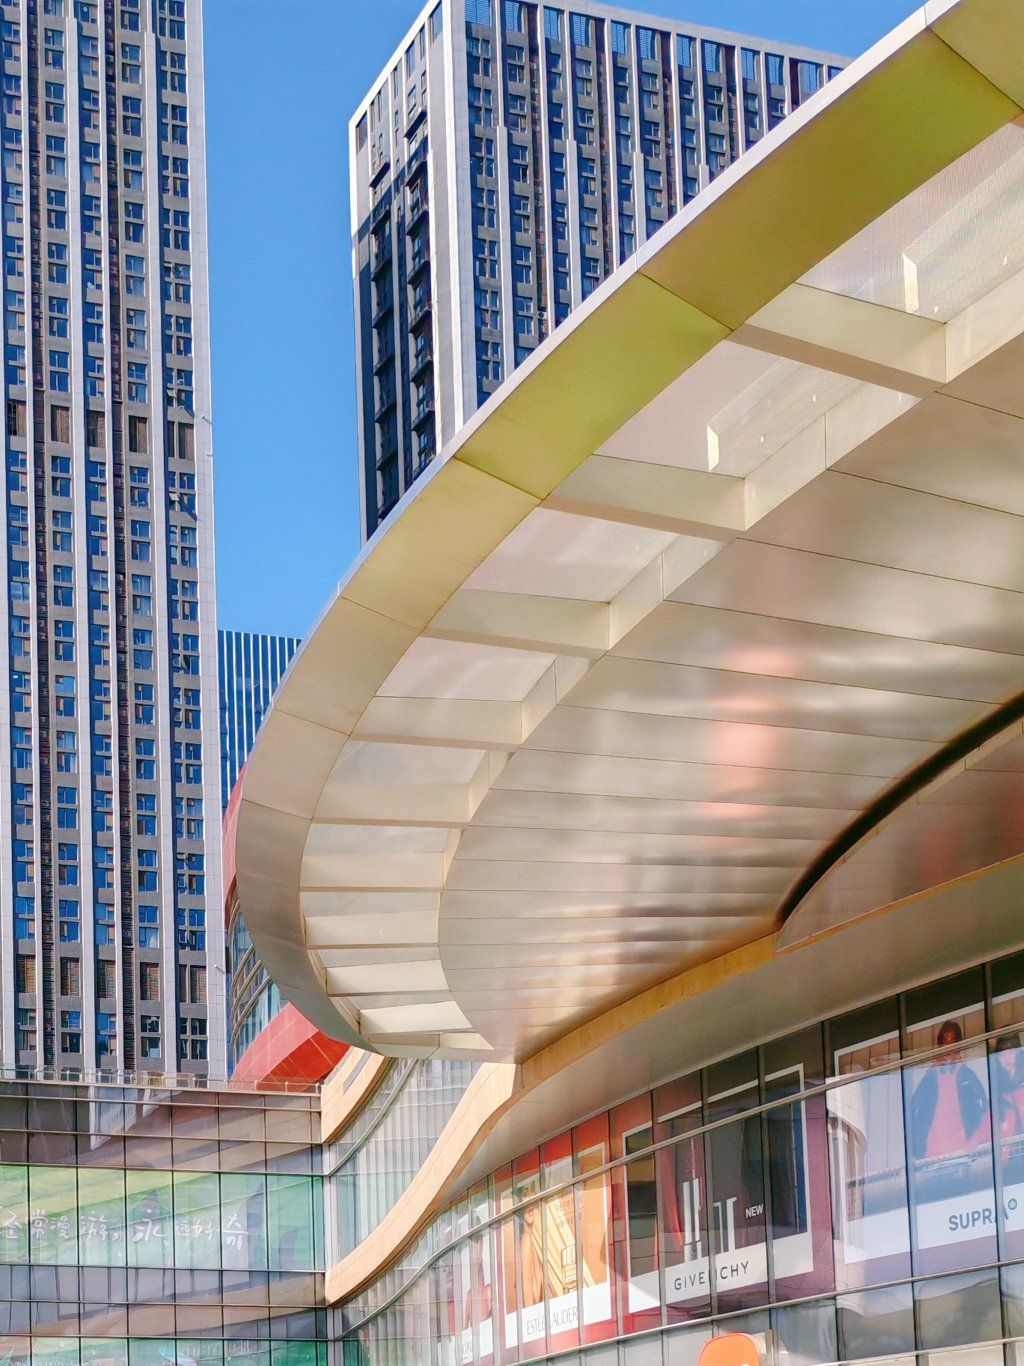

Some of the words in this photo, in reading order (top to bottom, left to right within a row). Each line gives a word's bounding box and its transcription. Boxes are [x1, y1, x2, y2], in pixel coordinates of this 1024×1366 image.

[744, 1203, 764, 1219] NEW
[673, 1260, 749, 1291] GIVECHY
[547, 1306, 579, 1328] AUDER
